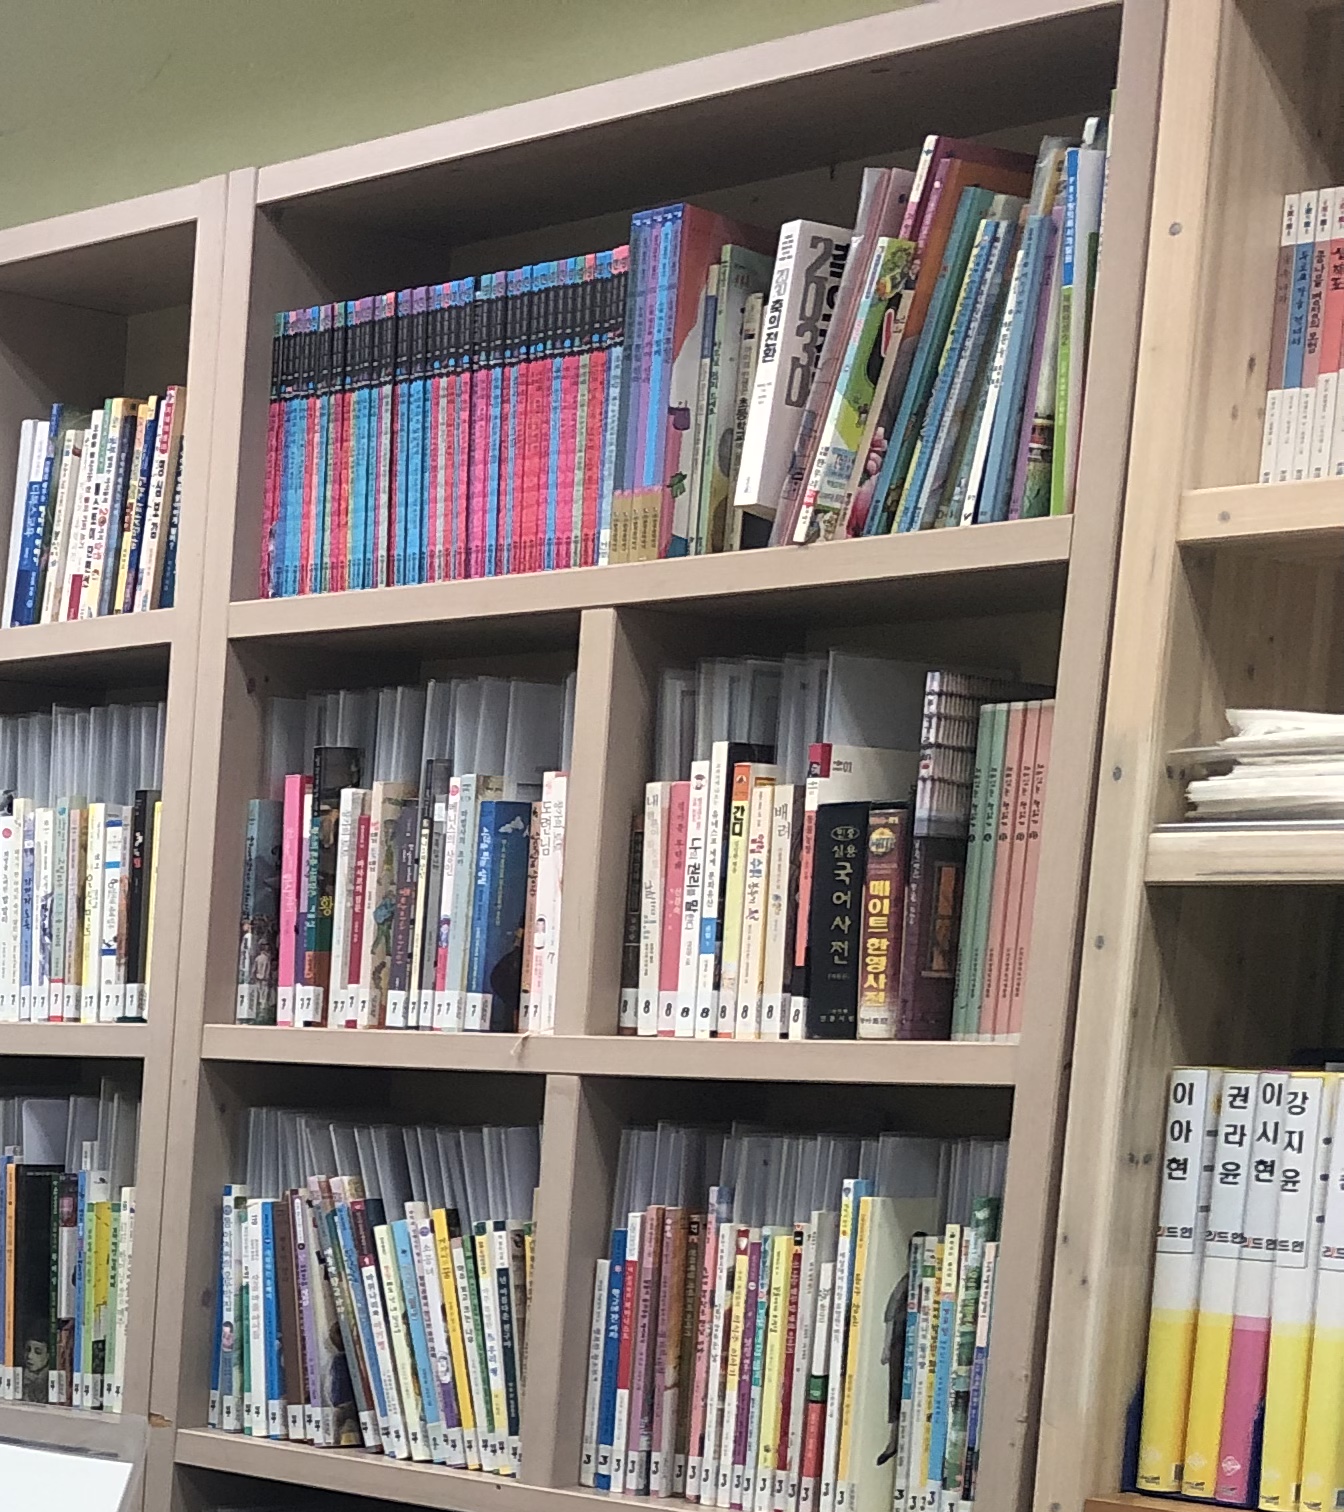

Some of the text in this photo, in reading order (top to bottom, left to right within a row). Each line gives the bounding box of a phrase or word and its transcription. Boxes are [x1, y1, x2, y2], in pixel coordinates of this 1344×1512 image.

[830, 861, 854, 966] 국어사전
[862, 879, 891, 1008] 메이트 한영사전
[1165, 1080, 1196, 1182] 이아현
[1218, 1085, 1251, 1186] 권라윤
[1253, 1080, 1284, 1184] 이시현
[1278, 1090, 1310, 1193] 강지윤
